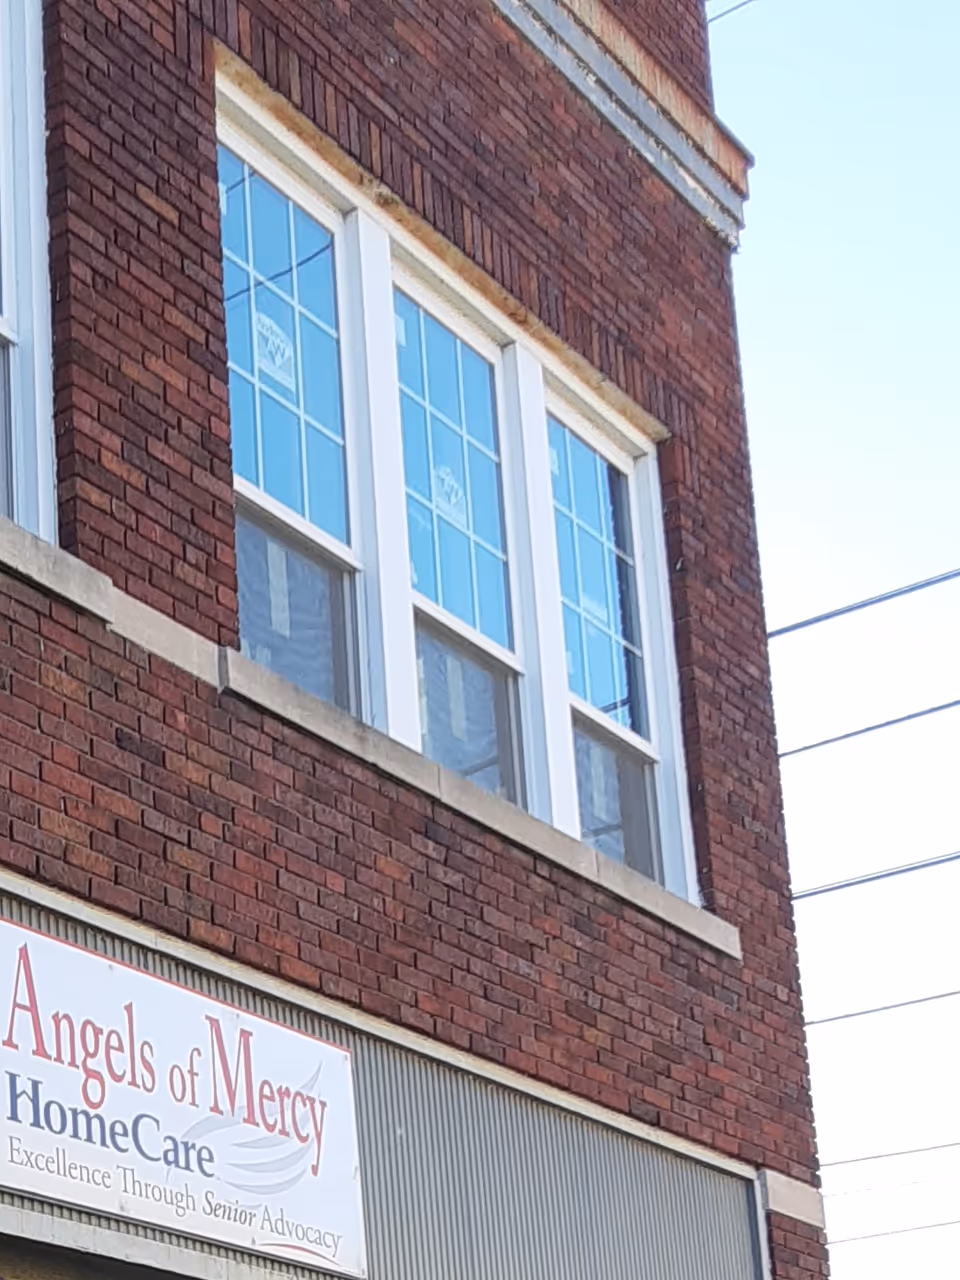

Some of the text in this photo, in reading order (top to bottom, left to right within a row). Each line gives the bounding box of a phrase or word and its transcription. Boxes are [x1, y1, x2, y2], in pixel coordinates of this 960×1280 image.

[2, 943, 327, 1177] Angels of Mercy
[5, 1070, 216, 1178] HomeCare
[7, 1136, 343, 1257] Excellence Through Senior Advocacy
